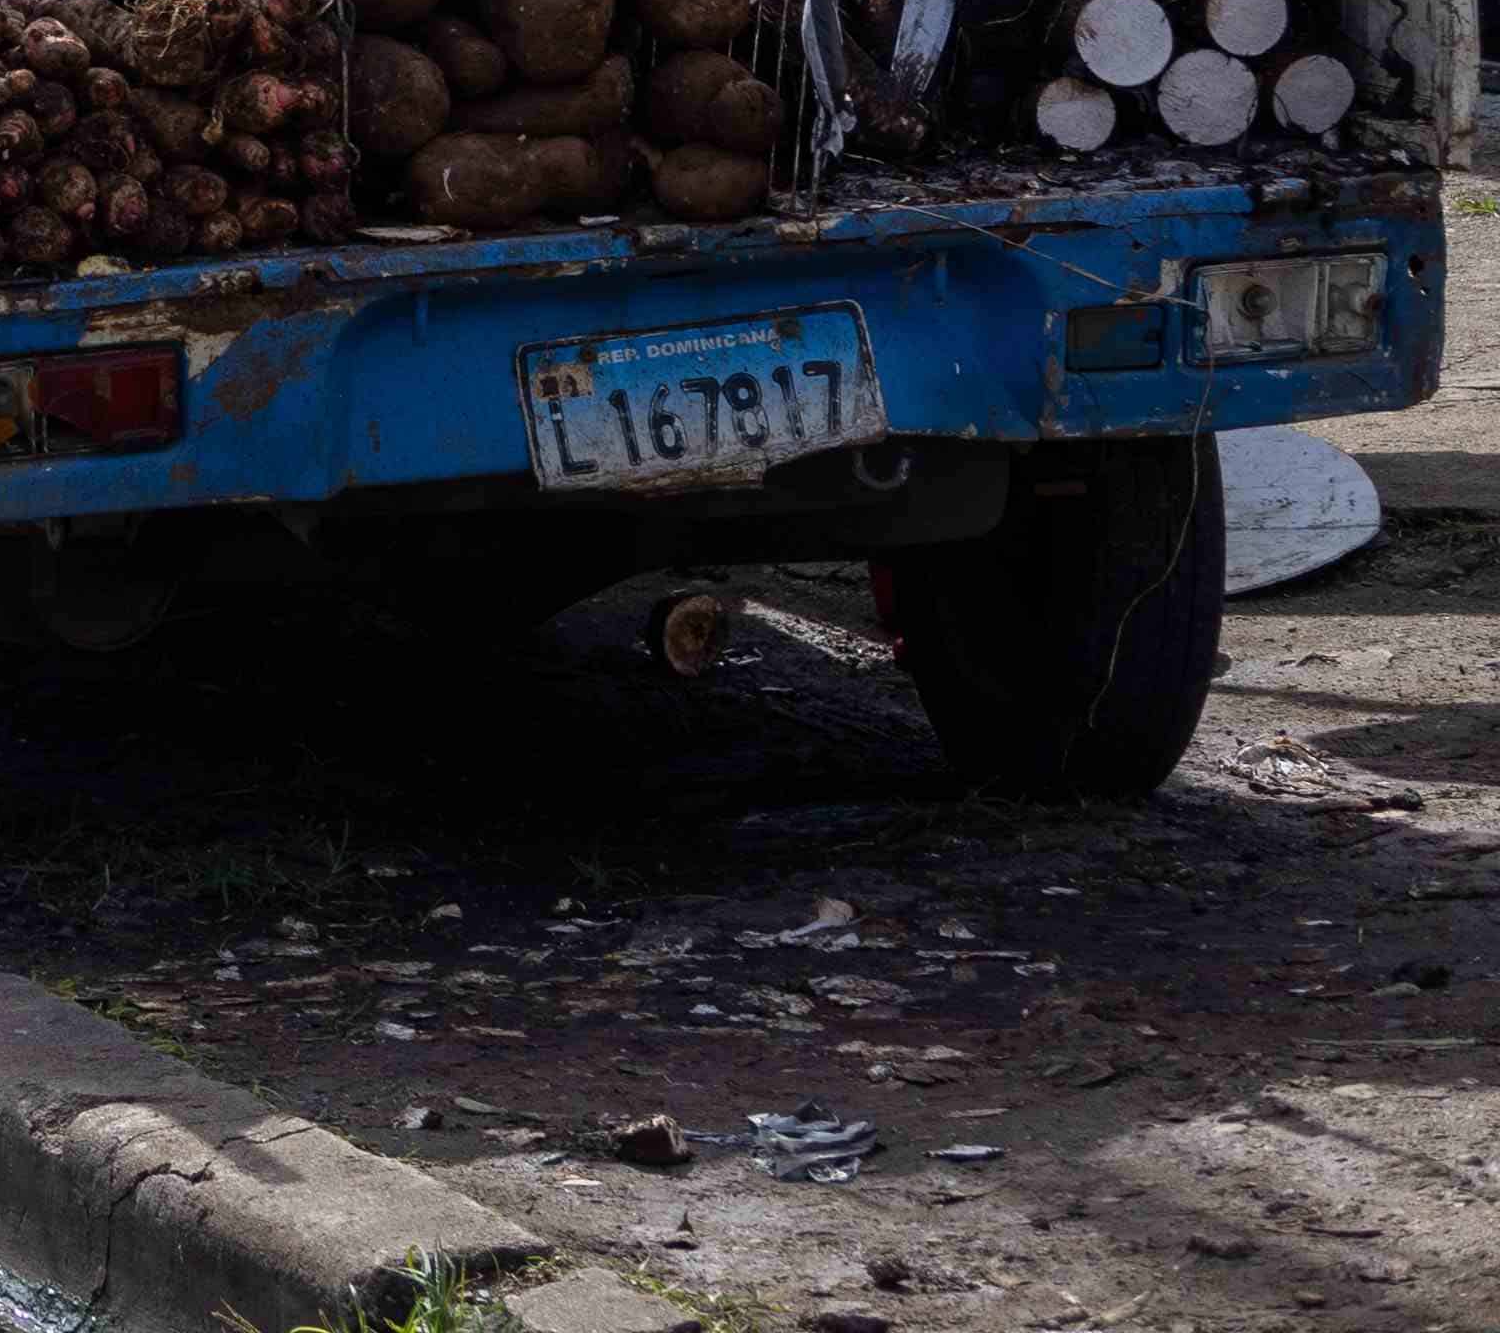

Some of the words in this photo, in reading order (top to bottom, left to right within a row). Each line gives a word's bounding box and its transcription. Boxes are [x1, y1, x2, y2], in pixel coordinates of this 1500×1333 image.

[597, 346, 642, 366] REP.
[646, 327, 781, 359] DOMINICANA
[547, 359, 844, 476] L167817
